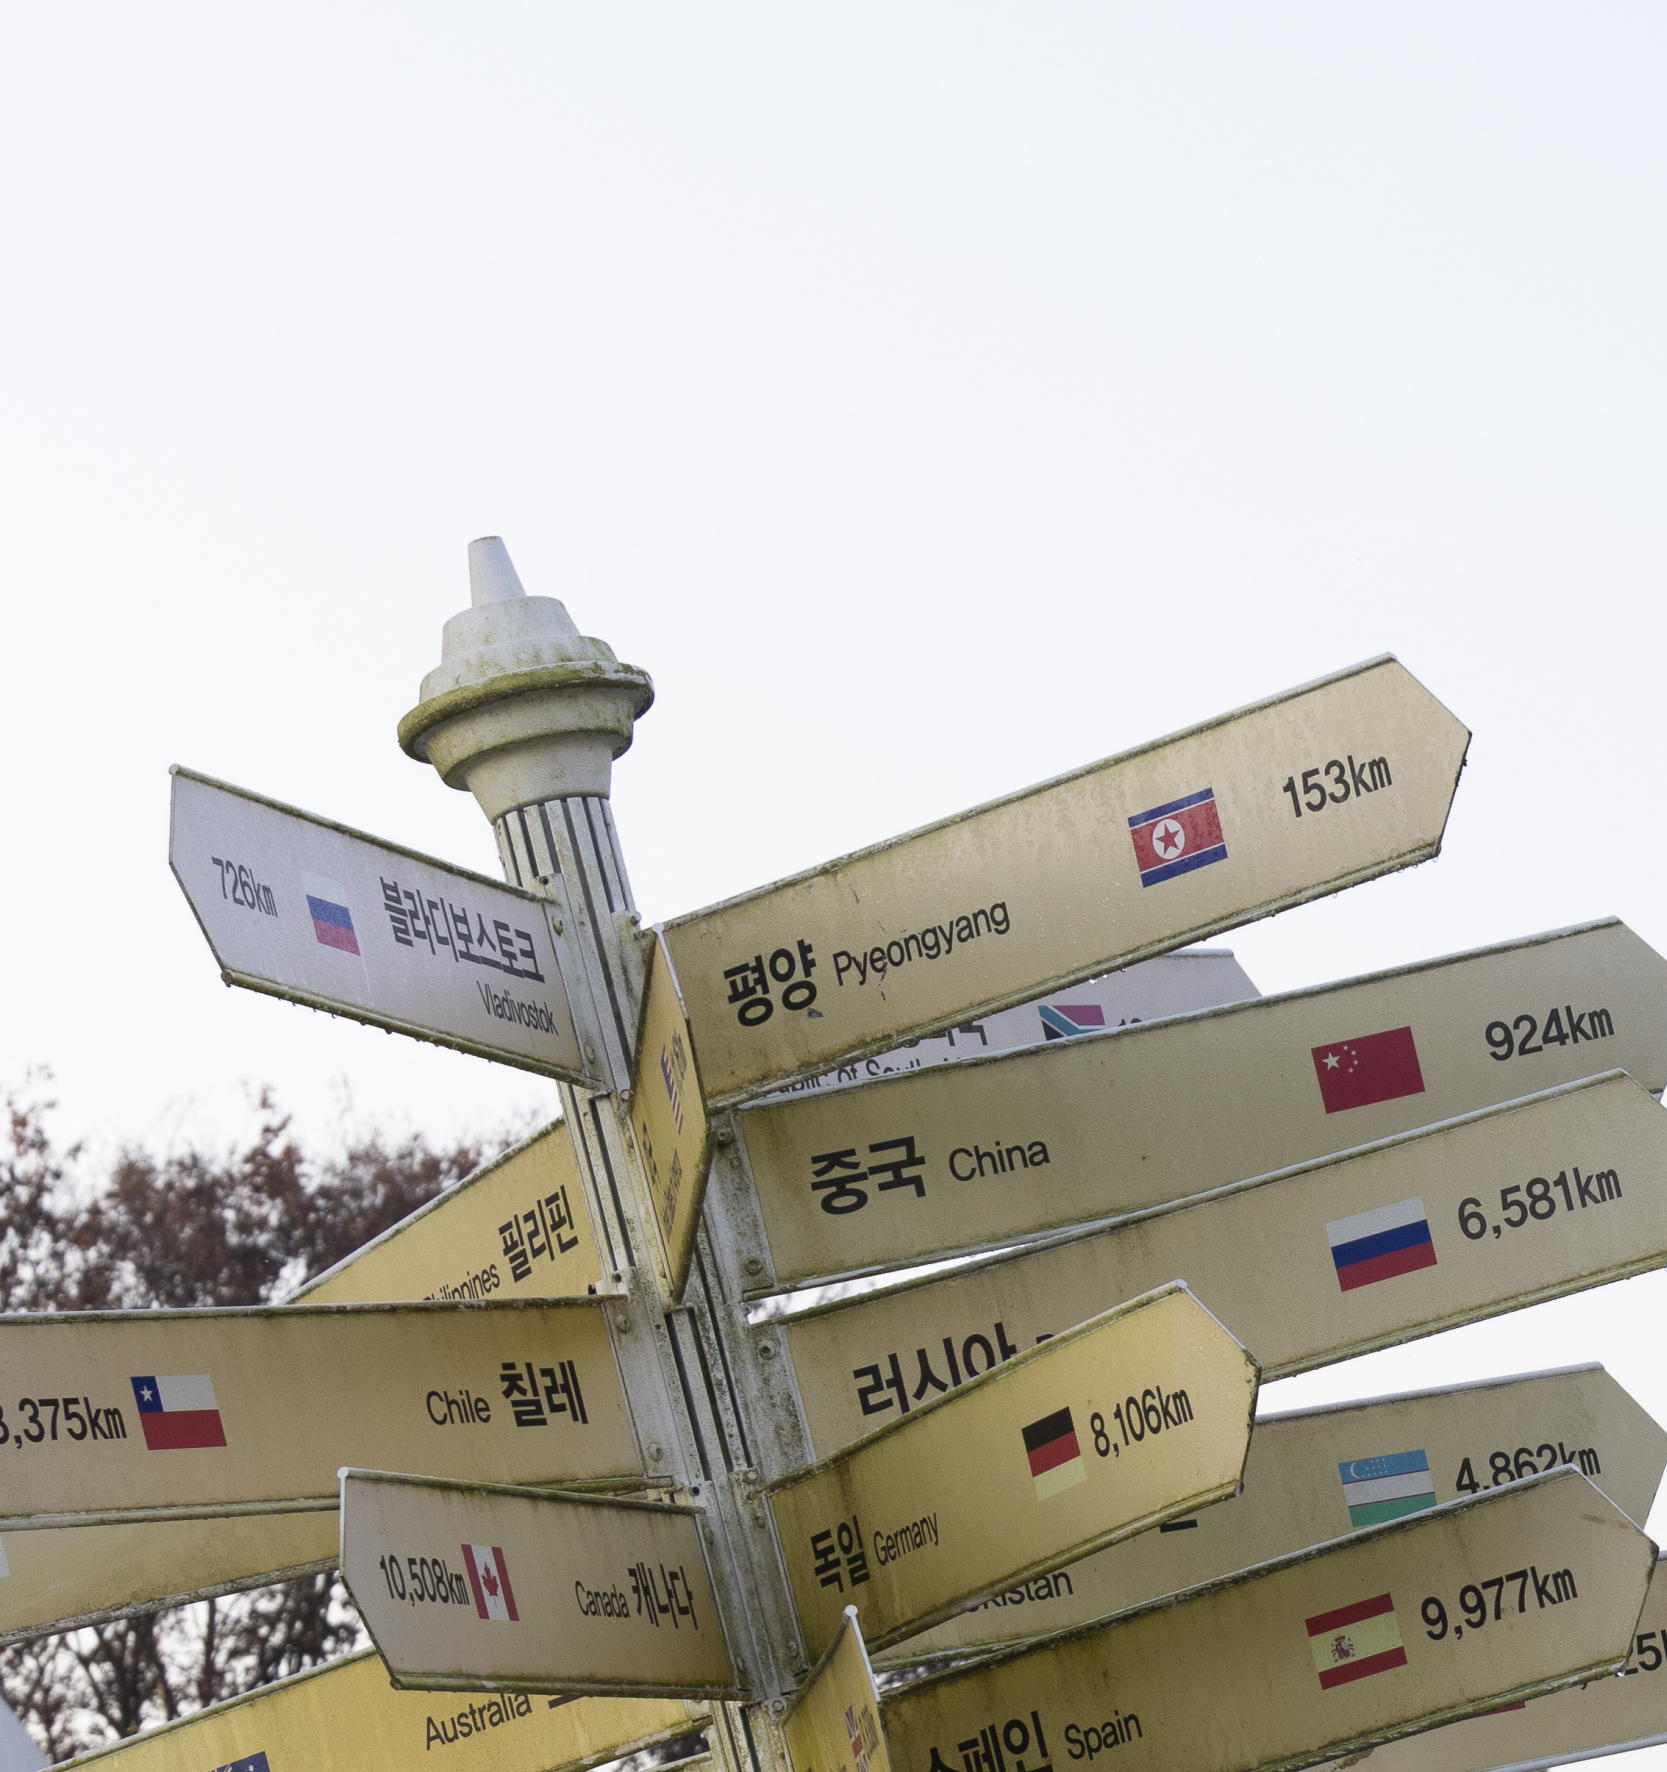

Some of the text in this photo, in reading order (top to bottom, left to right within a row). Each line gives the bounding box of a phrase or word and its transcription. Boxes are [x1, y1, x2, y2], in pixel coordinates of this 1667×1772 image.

[1282, 753, 1393, 818] 153km
[211, 857, 279, 918] 726km
[380, 876, 546, 984] 블라디보스토크
[723, 901, 1010, 1027] 평양 Pyeongyang
[477, 981, 559, 1036] Vladivostok
[1485, 1004, 1615, 1063] 924km
[810, 1135, 1050, 1216] 중국 China
[1456, 1165, 1622, 1242] 6,581km
[498, 1184, 579, 1283] 필리핀
[426, 1360, 589, 1428] Chile 칠레
[1090, 1385, 1194, 1458] 8,106km
[378, 1554, 470, 1606] 10,508km
[811, 1512, 940, 1593] 독일 Germany
[573, 1563, 697, 1630] Canada 캐나다
[1420, 1566, 1578, 1641] 9,977km
[424, 1692, 533, 1752] Australia
[1064, 1710, 1143, 1760] Spain
